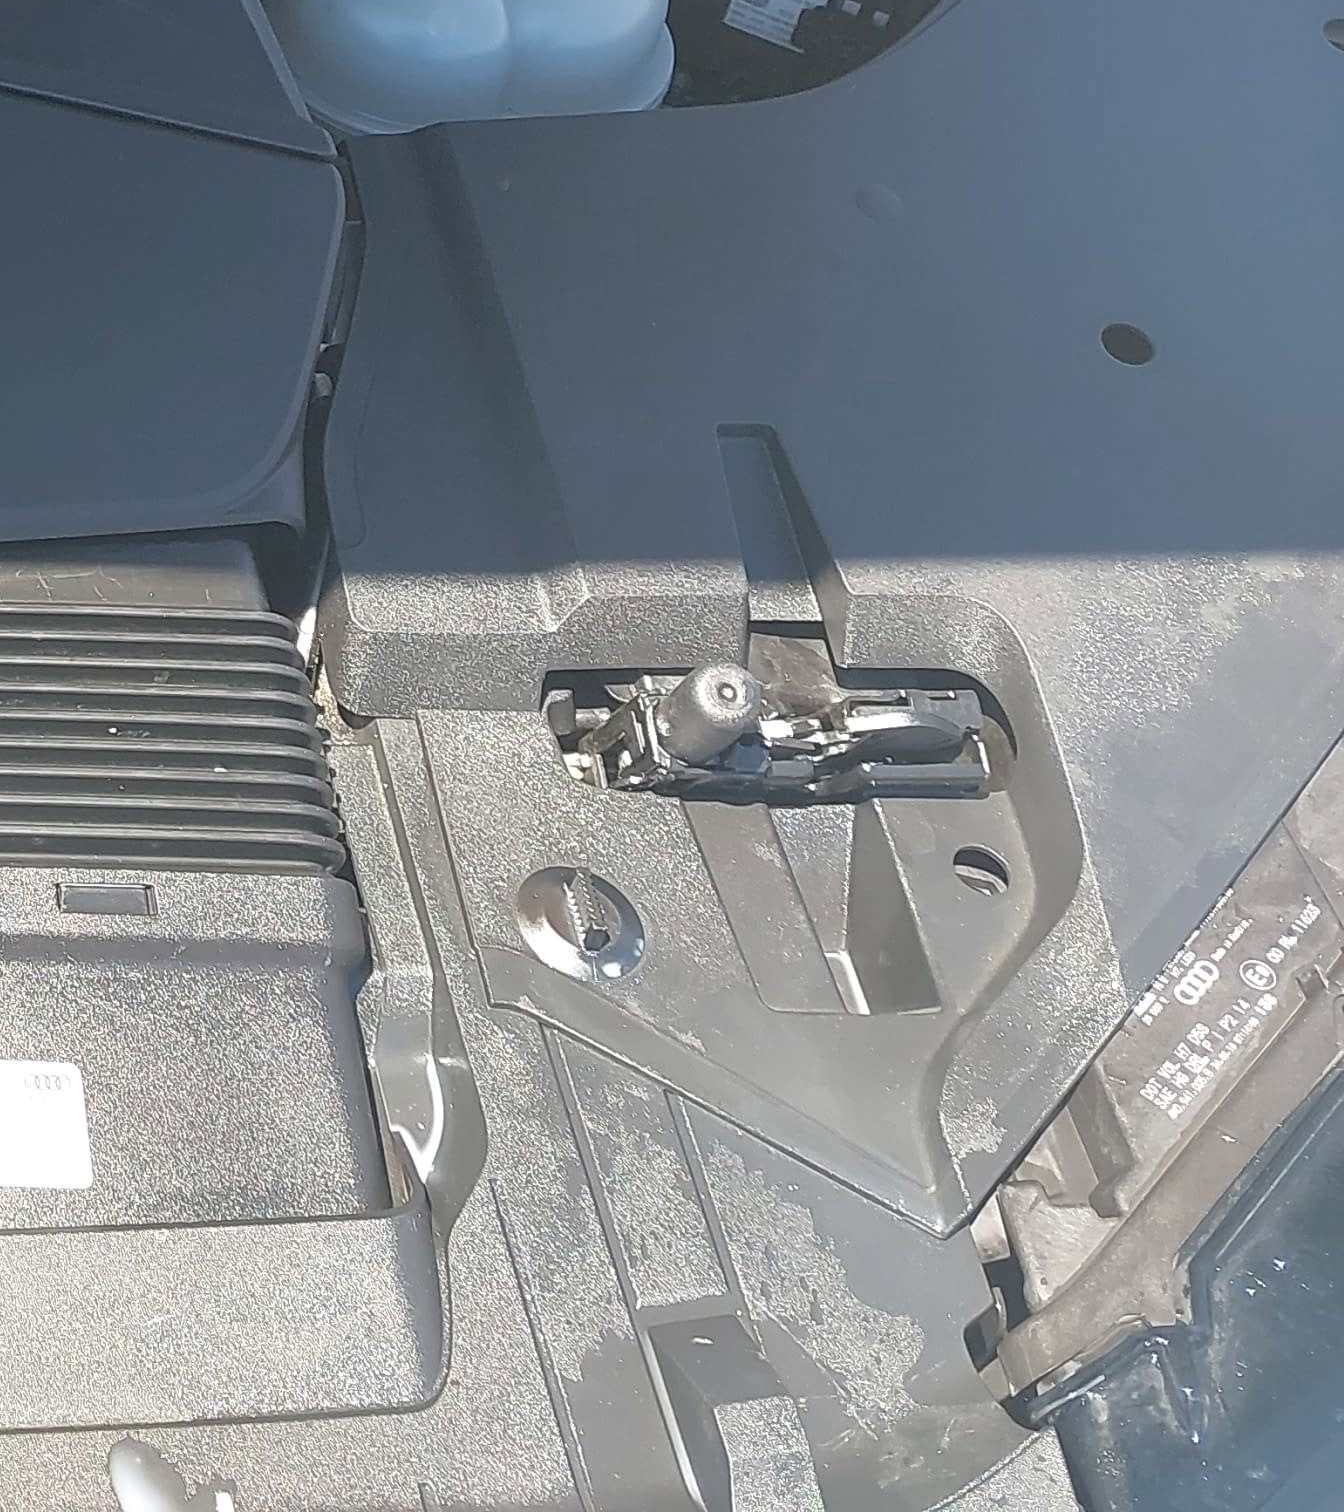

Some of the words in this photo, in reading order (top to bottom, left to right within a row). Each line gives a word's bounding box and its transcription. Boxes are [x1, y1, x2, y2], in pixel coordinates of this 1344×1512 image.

[1140, 1078, 1162, 1100] DOT
[1157, 1061, 1180, 1079] VOL
[1174, 1042, 1192, 1061] H7
[1152, 1087, 1177, 1109] SAE
[1182, 1053, 1210, 1075] DRL
[1217, 1015, 1239, 1032] P2
